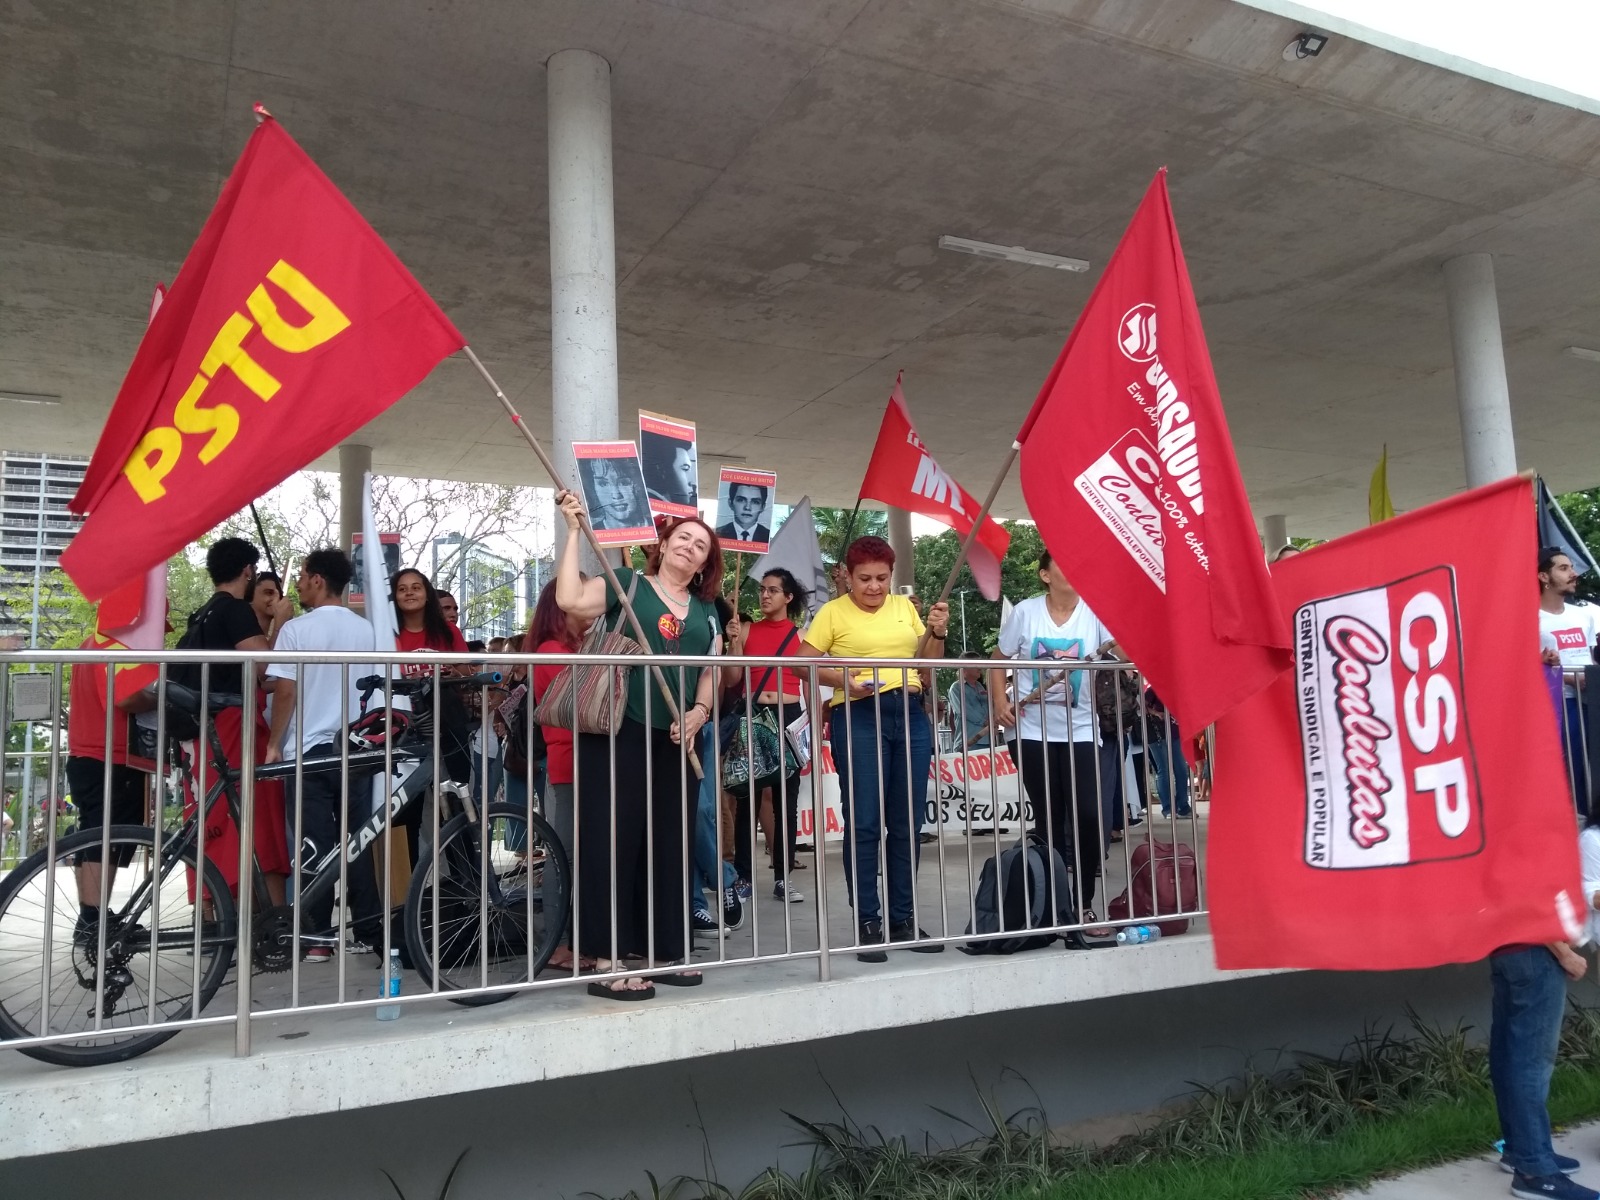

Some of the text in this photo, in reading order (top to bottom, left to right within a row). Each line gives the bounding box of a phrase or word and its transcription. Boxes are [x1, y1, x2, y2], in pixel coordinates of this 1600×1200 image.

[121, 258, 352, 505] PSTU
[1126, 382, 1146, 405] Em
[1161, 492, 1189, 529] 100%
[1559, 632, 1583, 644] PSTU
[953, 750, 1018, 783] CORRE
[1300, 608, 1328, 864] CENTRAL SINDICAL E POPULAR
[1323, 614, 1392, 850] Conlutas
[1400, 591, 1470, 838] CSP
